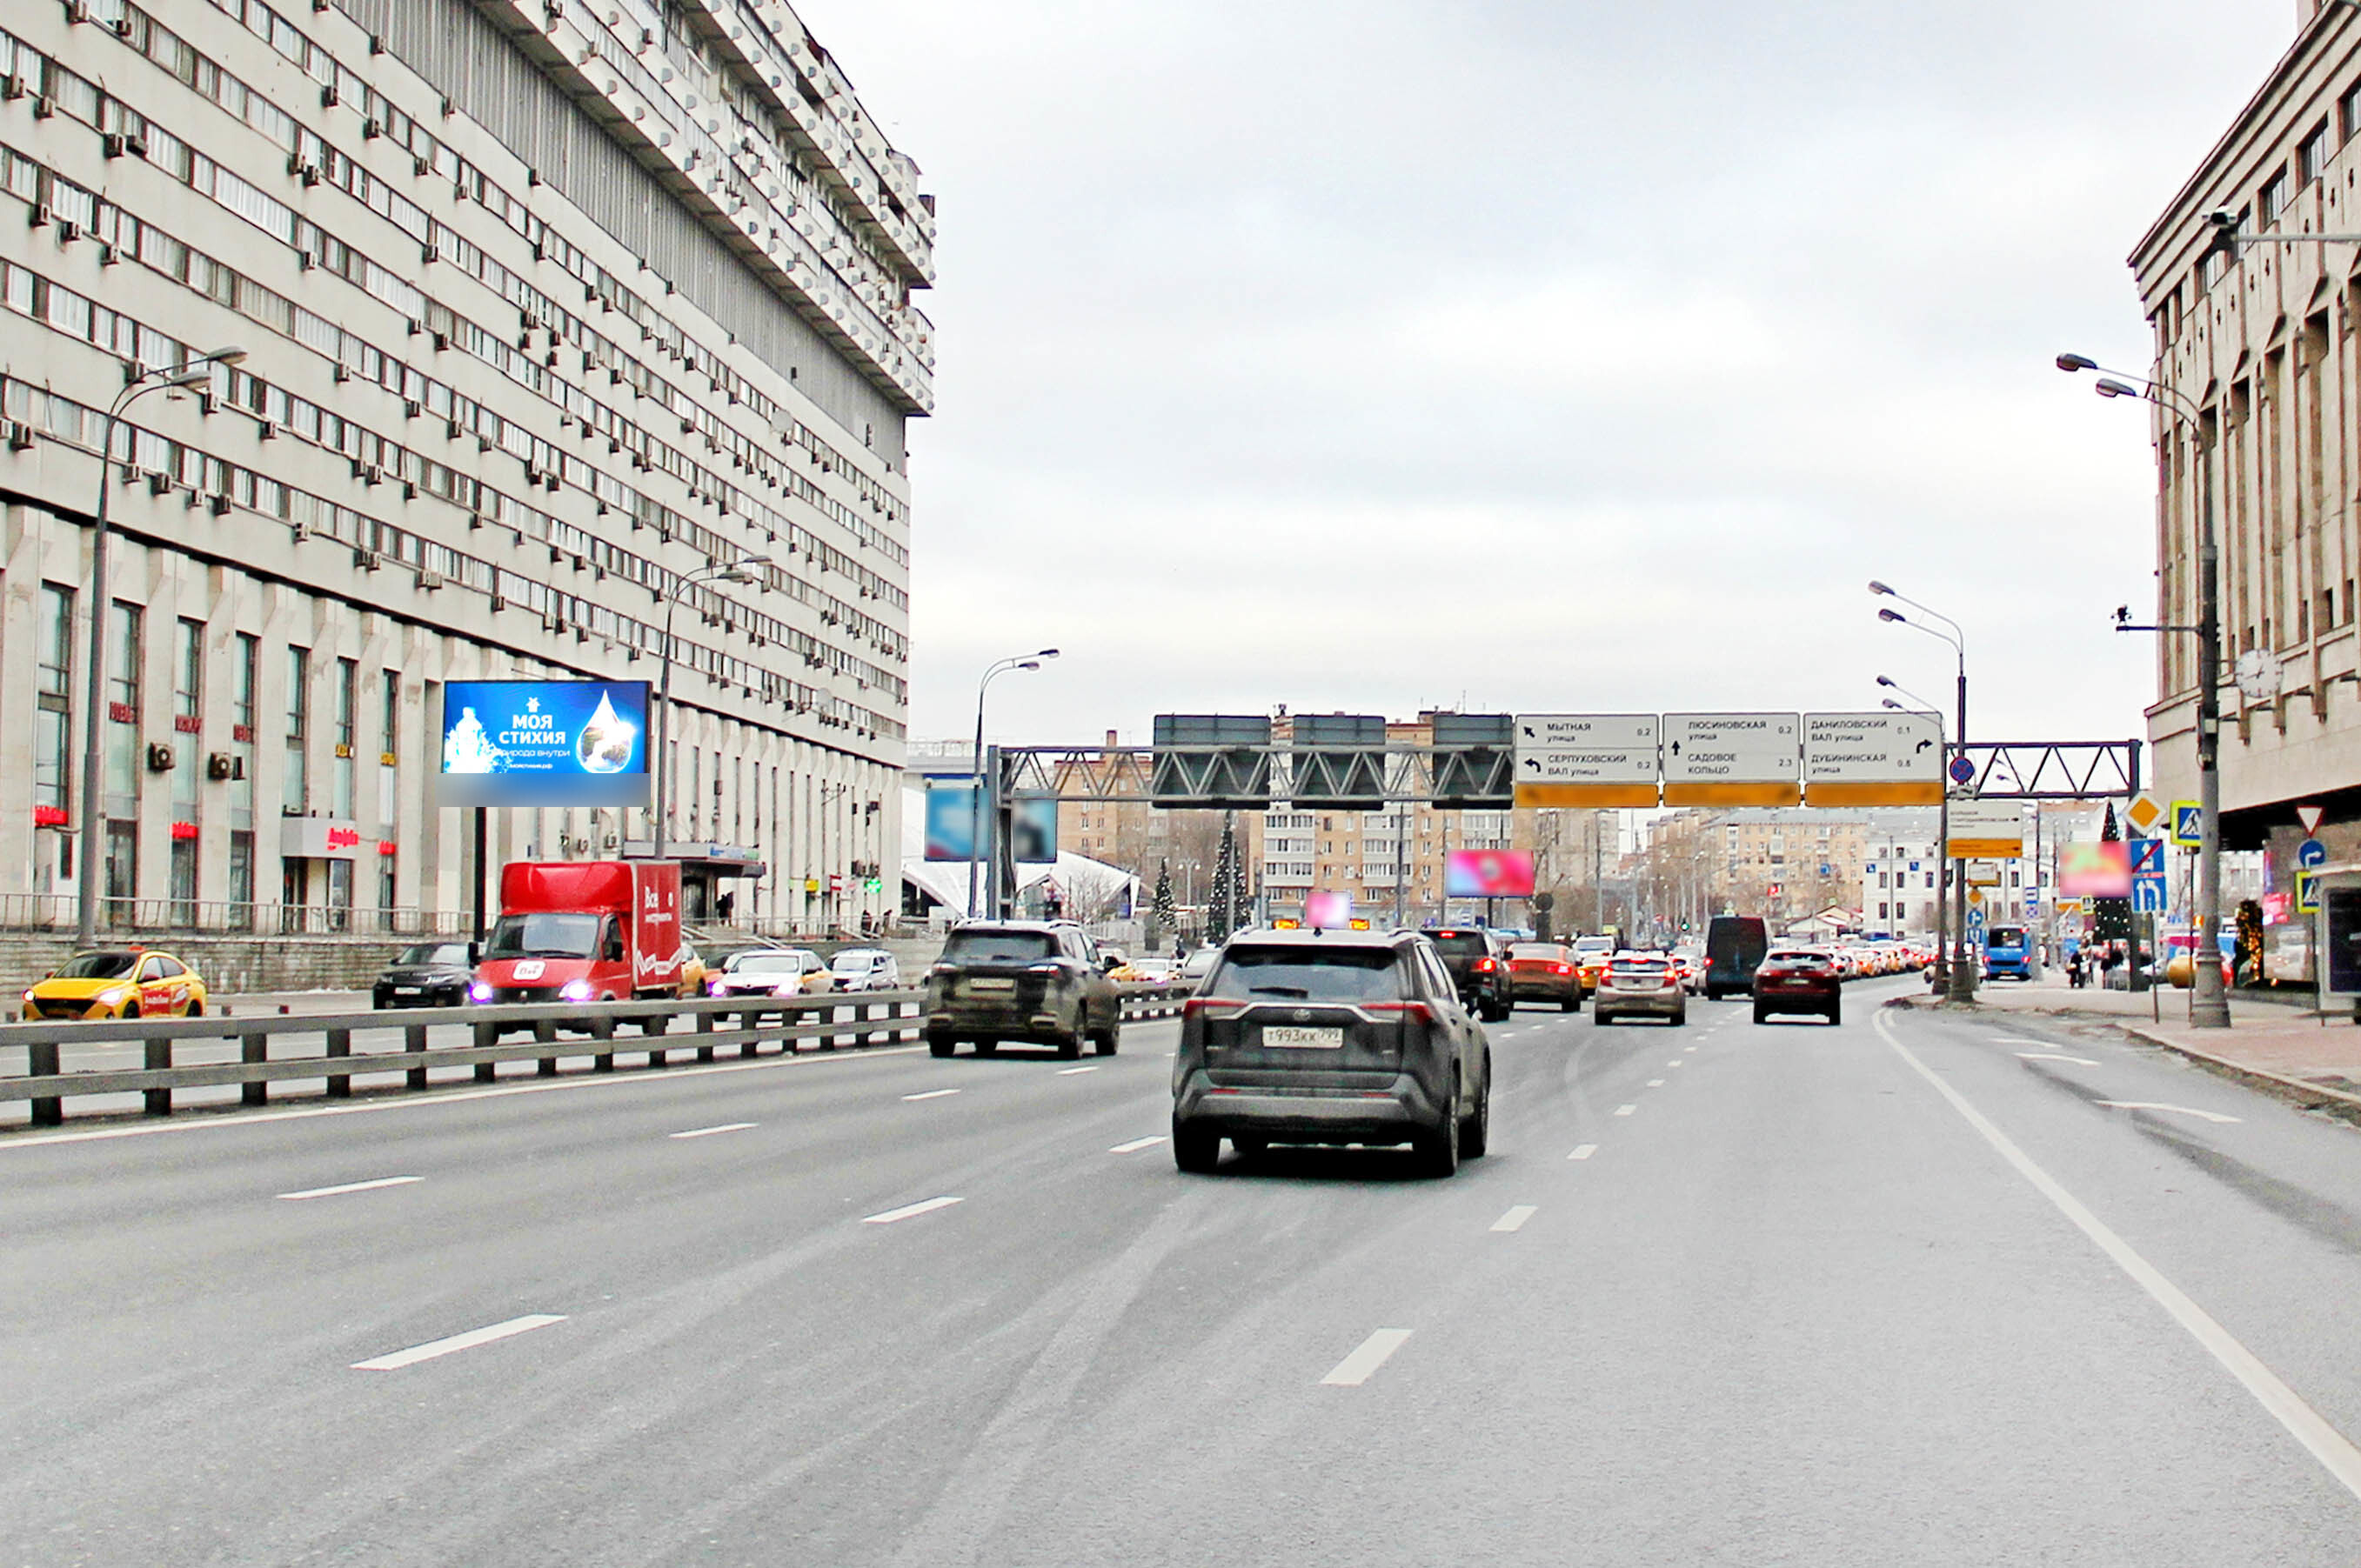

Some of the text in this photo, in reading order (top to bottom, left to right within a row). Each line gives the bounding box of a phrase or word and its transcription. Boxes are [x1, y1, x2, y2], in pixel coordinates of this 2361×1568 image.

[512, 715, 552, 729] МОЯ
[1688, 721, 1767, 730] ЛЮСИНОВСКАЯ
[1810, 720, 1888, 730] ДАНИЛОВСКИЙ
[1547, 723, 1591, 731] МЫТНАЯ
[498, 731, 566, 744] СТИХИЯ
[1547, 735, 1575, 744] улица
[1835, 734, 1863, 743] улица
[537, 750, 571, 758] внутри
[1688, 753, 1736, 763] САДОВОЕ
[1810, 754, 1887, 763] ДУБИНИНСКАЯ
[1548, 754, 1627, 764] СЕРПУХОВСКИЙ
[1570, 769, 1599, 777] улица
[1688, 766, 1730, 775] КОЛЬЦО
